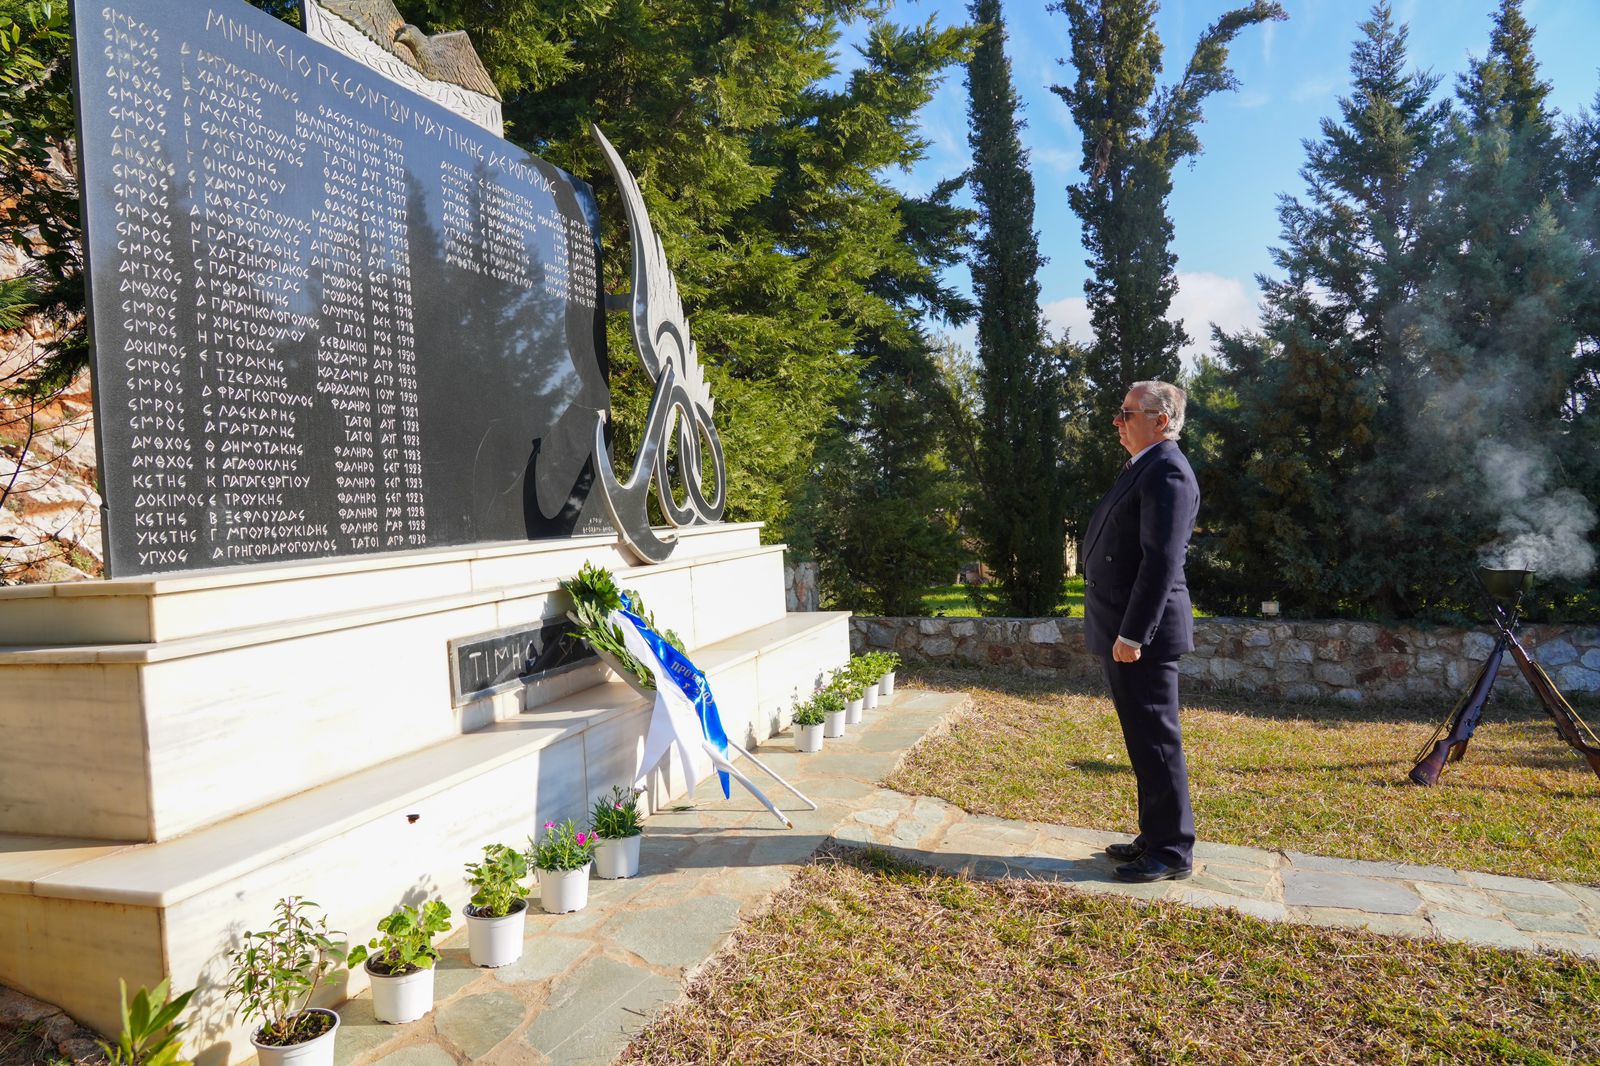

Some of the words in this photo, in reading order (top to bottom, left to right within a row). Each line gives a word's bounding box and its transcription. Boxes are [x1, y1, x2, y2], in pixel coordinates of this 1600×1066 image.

[206, 9, 311, 77] ΜΝΗΜΕΙΟ
[318, 63, 409, 124] ΠΕΣΟΝΤΩΝ
[414, 112, 484, 162] ΝΑΥΤΙΚΗΣ
[382, 133, 403, 150] 1917
[384, 148, 404, 164] 1917
[384, 162, 404, 178] 1917
[385, 176, 406, 192] 1917
[386, 191, 406, 206] 1917
[388, 206, 407, 220] 1917
[388, 220, 408, 235] 1917
[396, 320, 414, 334] 1918
[397, 334, 414, 348] 1919
[398, 349, 416, 362] 1920
[398, 362, 416, 376] 1920
[398, 378, 417, 390] 1920
[400, 391, 418, 403] 1920
[401, 406, 418, 417] 1921
[402, 420, 419, 432] 1923
[403, 434, 420, 446] 1923
[404, 450, 420, 460] 1923
[404, 464, 422, 474] 1923
[405, 478, 422, 488] 1923
[406, 492, 424, 503] 1923
[407, 506, 424, 516] 1928
[408, 520, 425, 530] 1928
[409, 534, 426, 544] 1930
